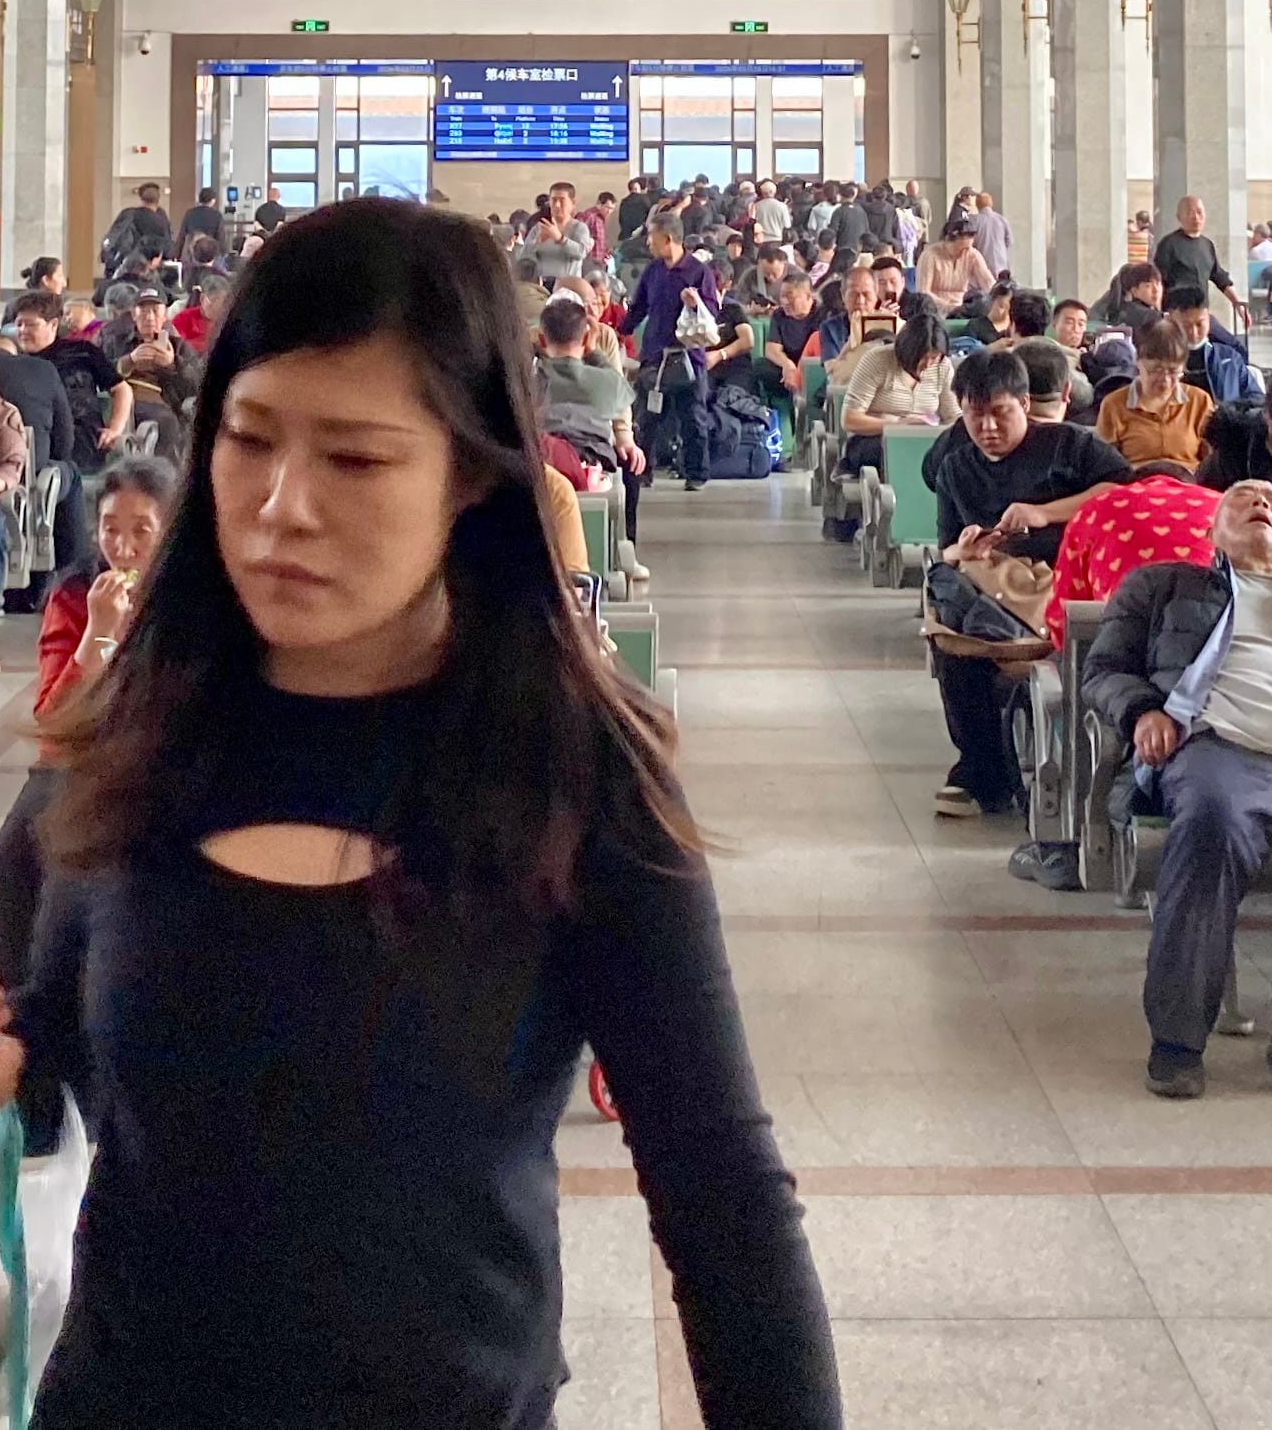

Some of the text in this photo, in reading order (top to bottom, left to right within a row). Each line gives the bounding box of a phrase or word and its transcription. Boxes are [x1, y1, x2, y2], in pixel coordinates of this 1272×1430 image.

[485, 68, 578, 81] 第4候车室检票口
